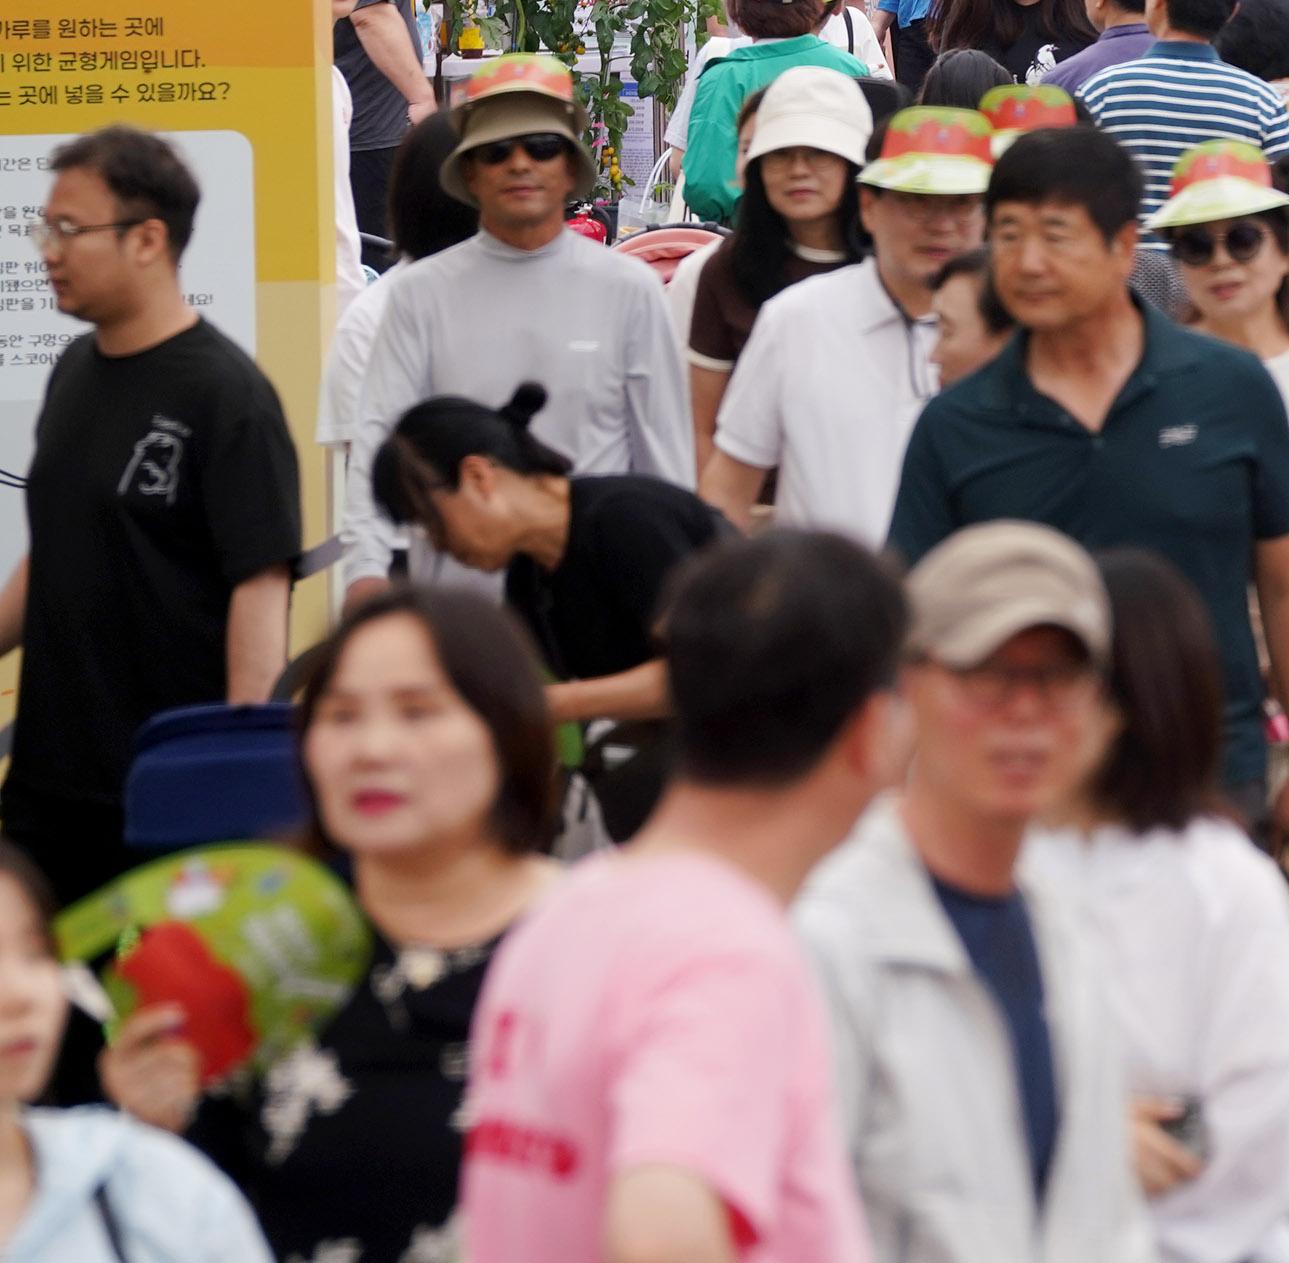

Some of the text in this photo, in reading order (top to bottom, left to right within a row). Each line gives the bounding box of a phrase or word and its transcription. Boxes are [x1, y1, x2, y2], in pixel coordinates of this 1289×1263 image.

[58, 18, 118, 38] 원하는
[124, 17, 164, 37] 곳에
[12, 49, 206, 72] 위한 균형게임입니다.
[18, 85, 57, 106] 곳에
[65, 84, 103, 105] 넣을
[111, 84, 130, 104] 수
[136, 82, 231, 103] 있을까요?
[0, 157, 31, 171] 간은
[182, 293, 213, 306] 네요!
